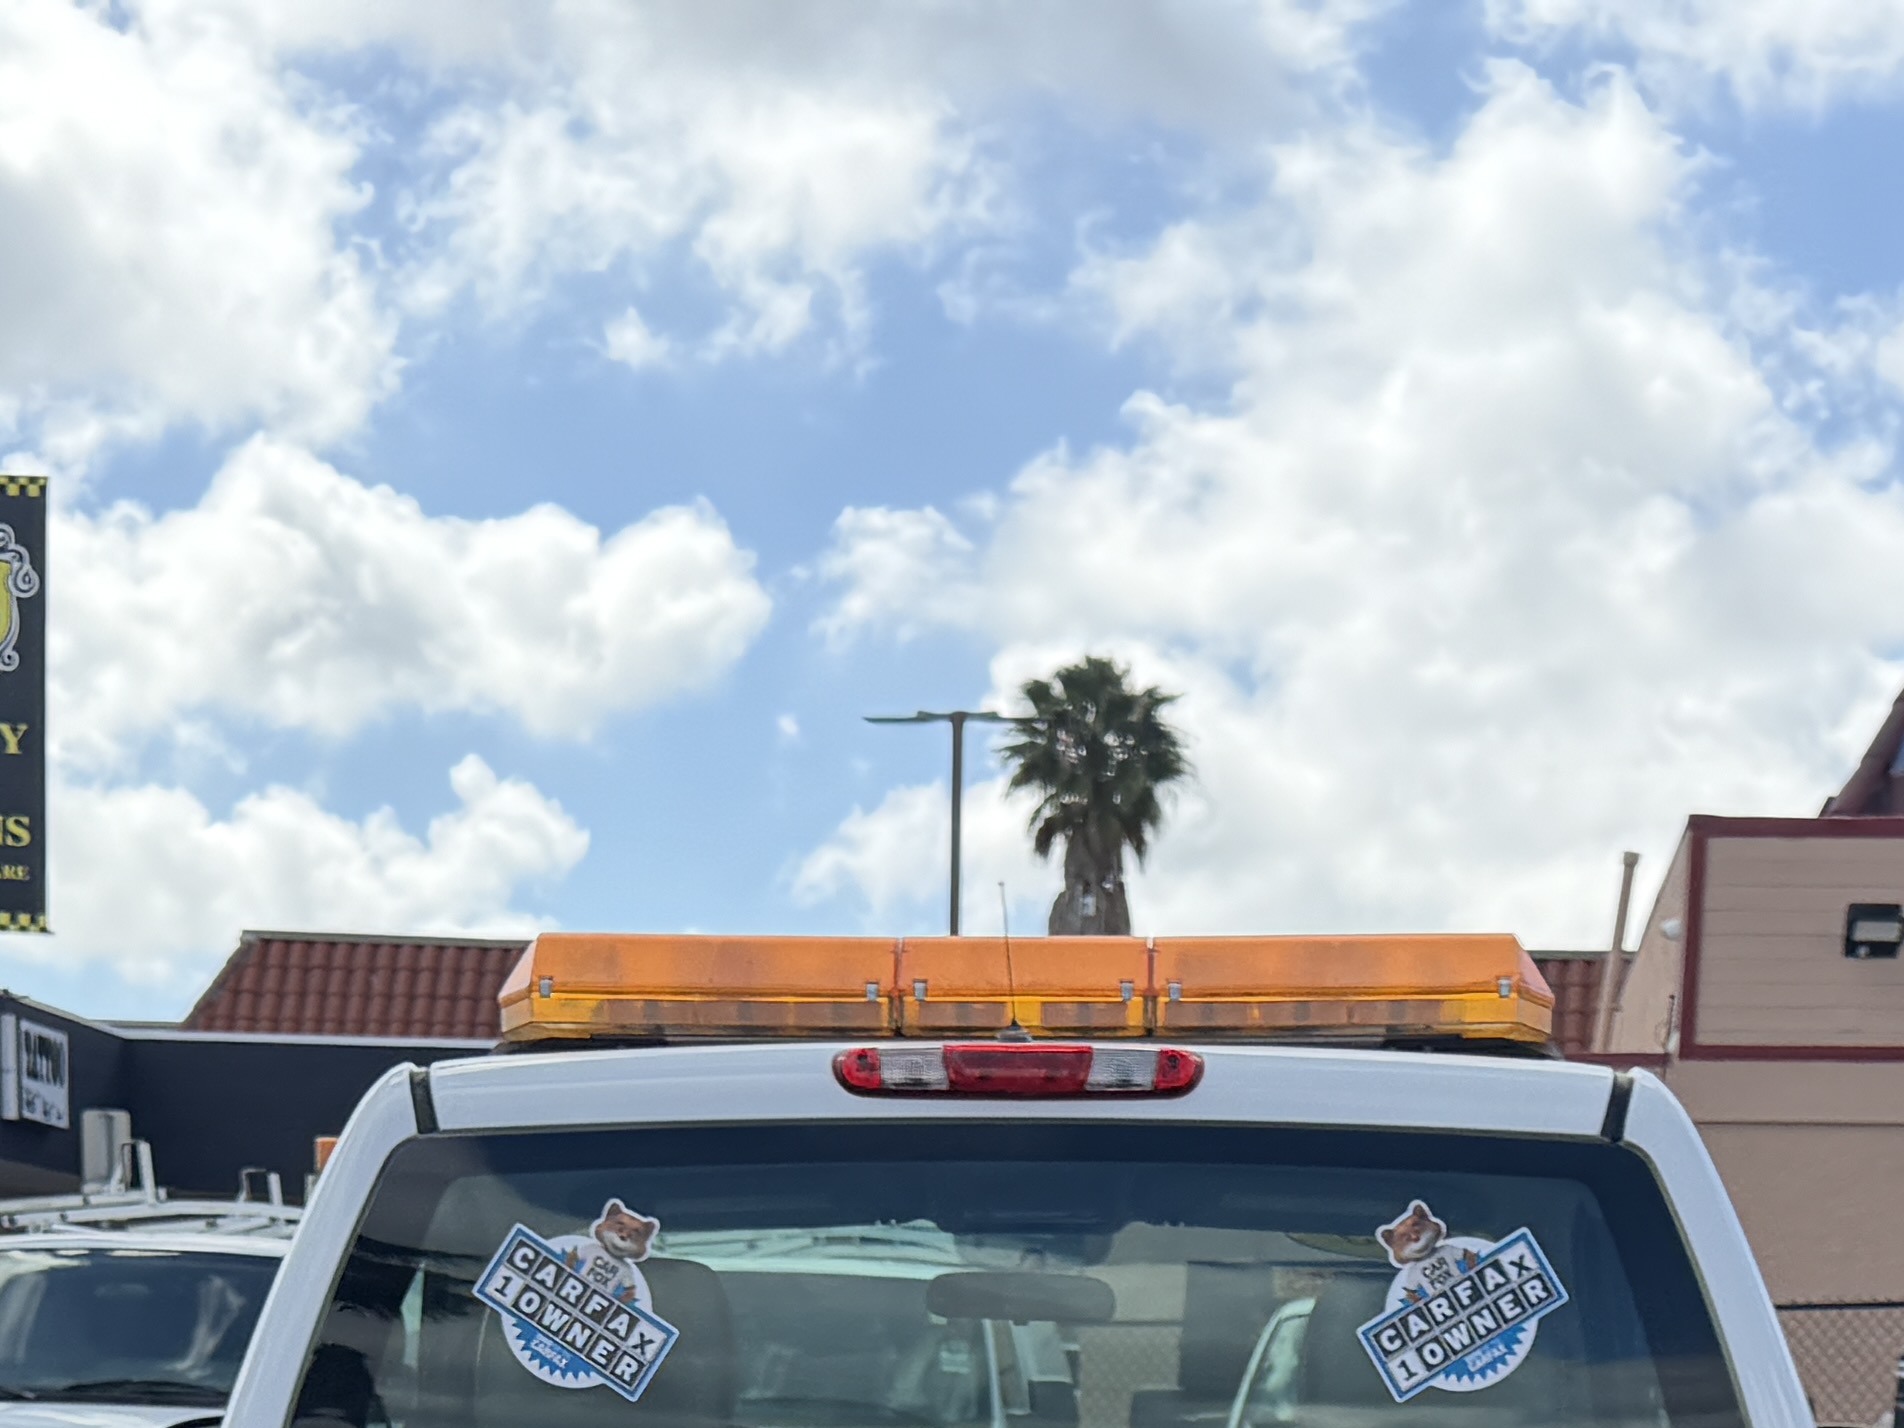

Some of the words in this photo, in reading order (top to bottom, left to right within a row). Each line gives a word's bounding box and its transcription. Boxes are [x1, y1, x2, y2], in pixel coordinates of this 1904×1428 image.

[586, 1267, 611, 1288] FOX
[593, 1255, 619, 1279] CAR
[513, 1246, 655, 1357] CARFAX
[1379, 1254, 1533, 1352] CARFAX
